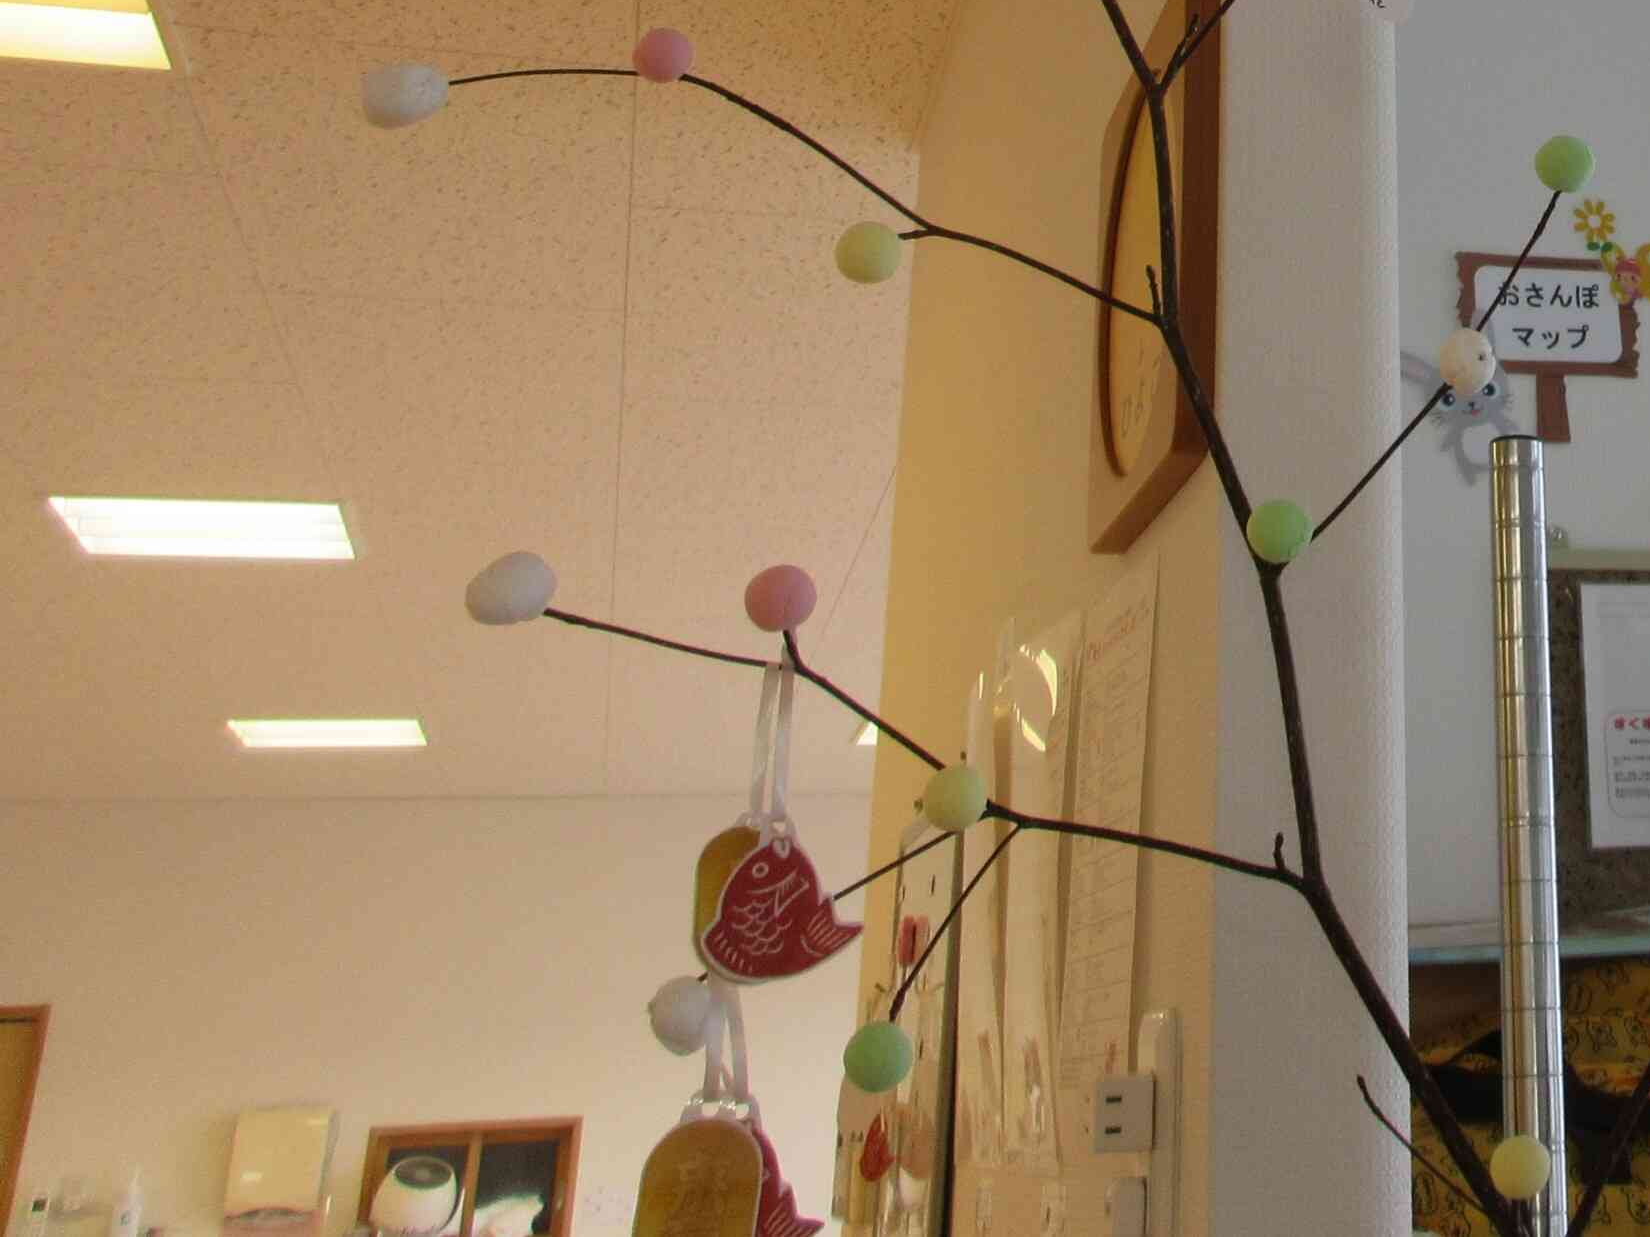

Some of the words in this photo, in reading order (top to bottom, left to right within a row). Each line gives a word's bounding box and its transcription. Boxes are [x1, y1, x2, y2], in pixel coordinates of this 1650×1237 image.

[1498, 281, 1600, 309] おさんぽ
[1512, 325, 1590, 350] マップ
